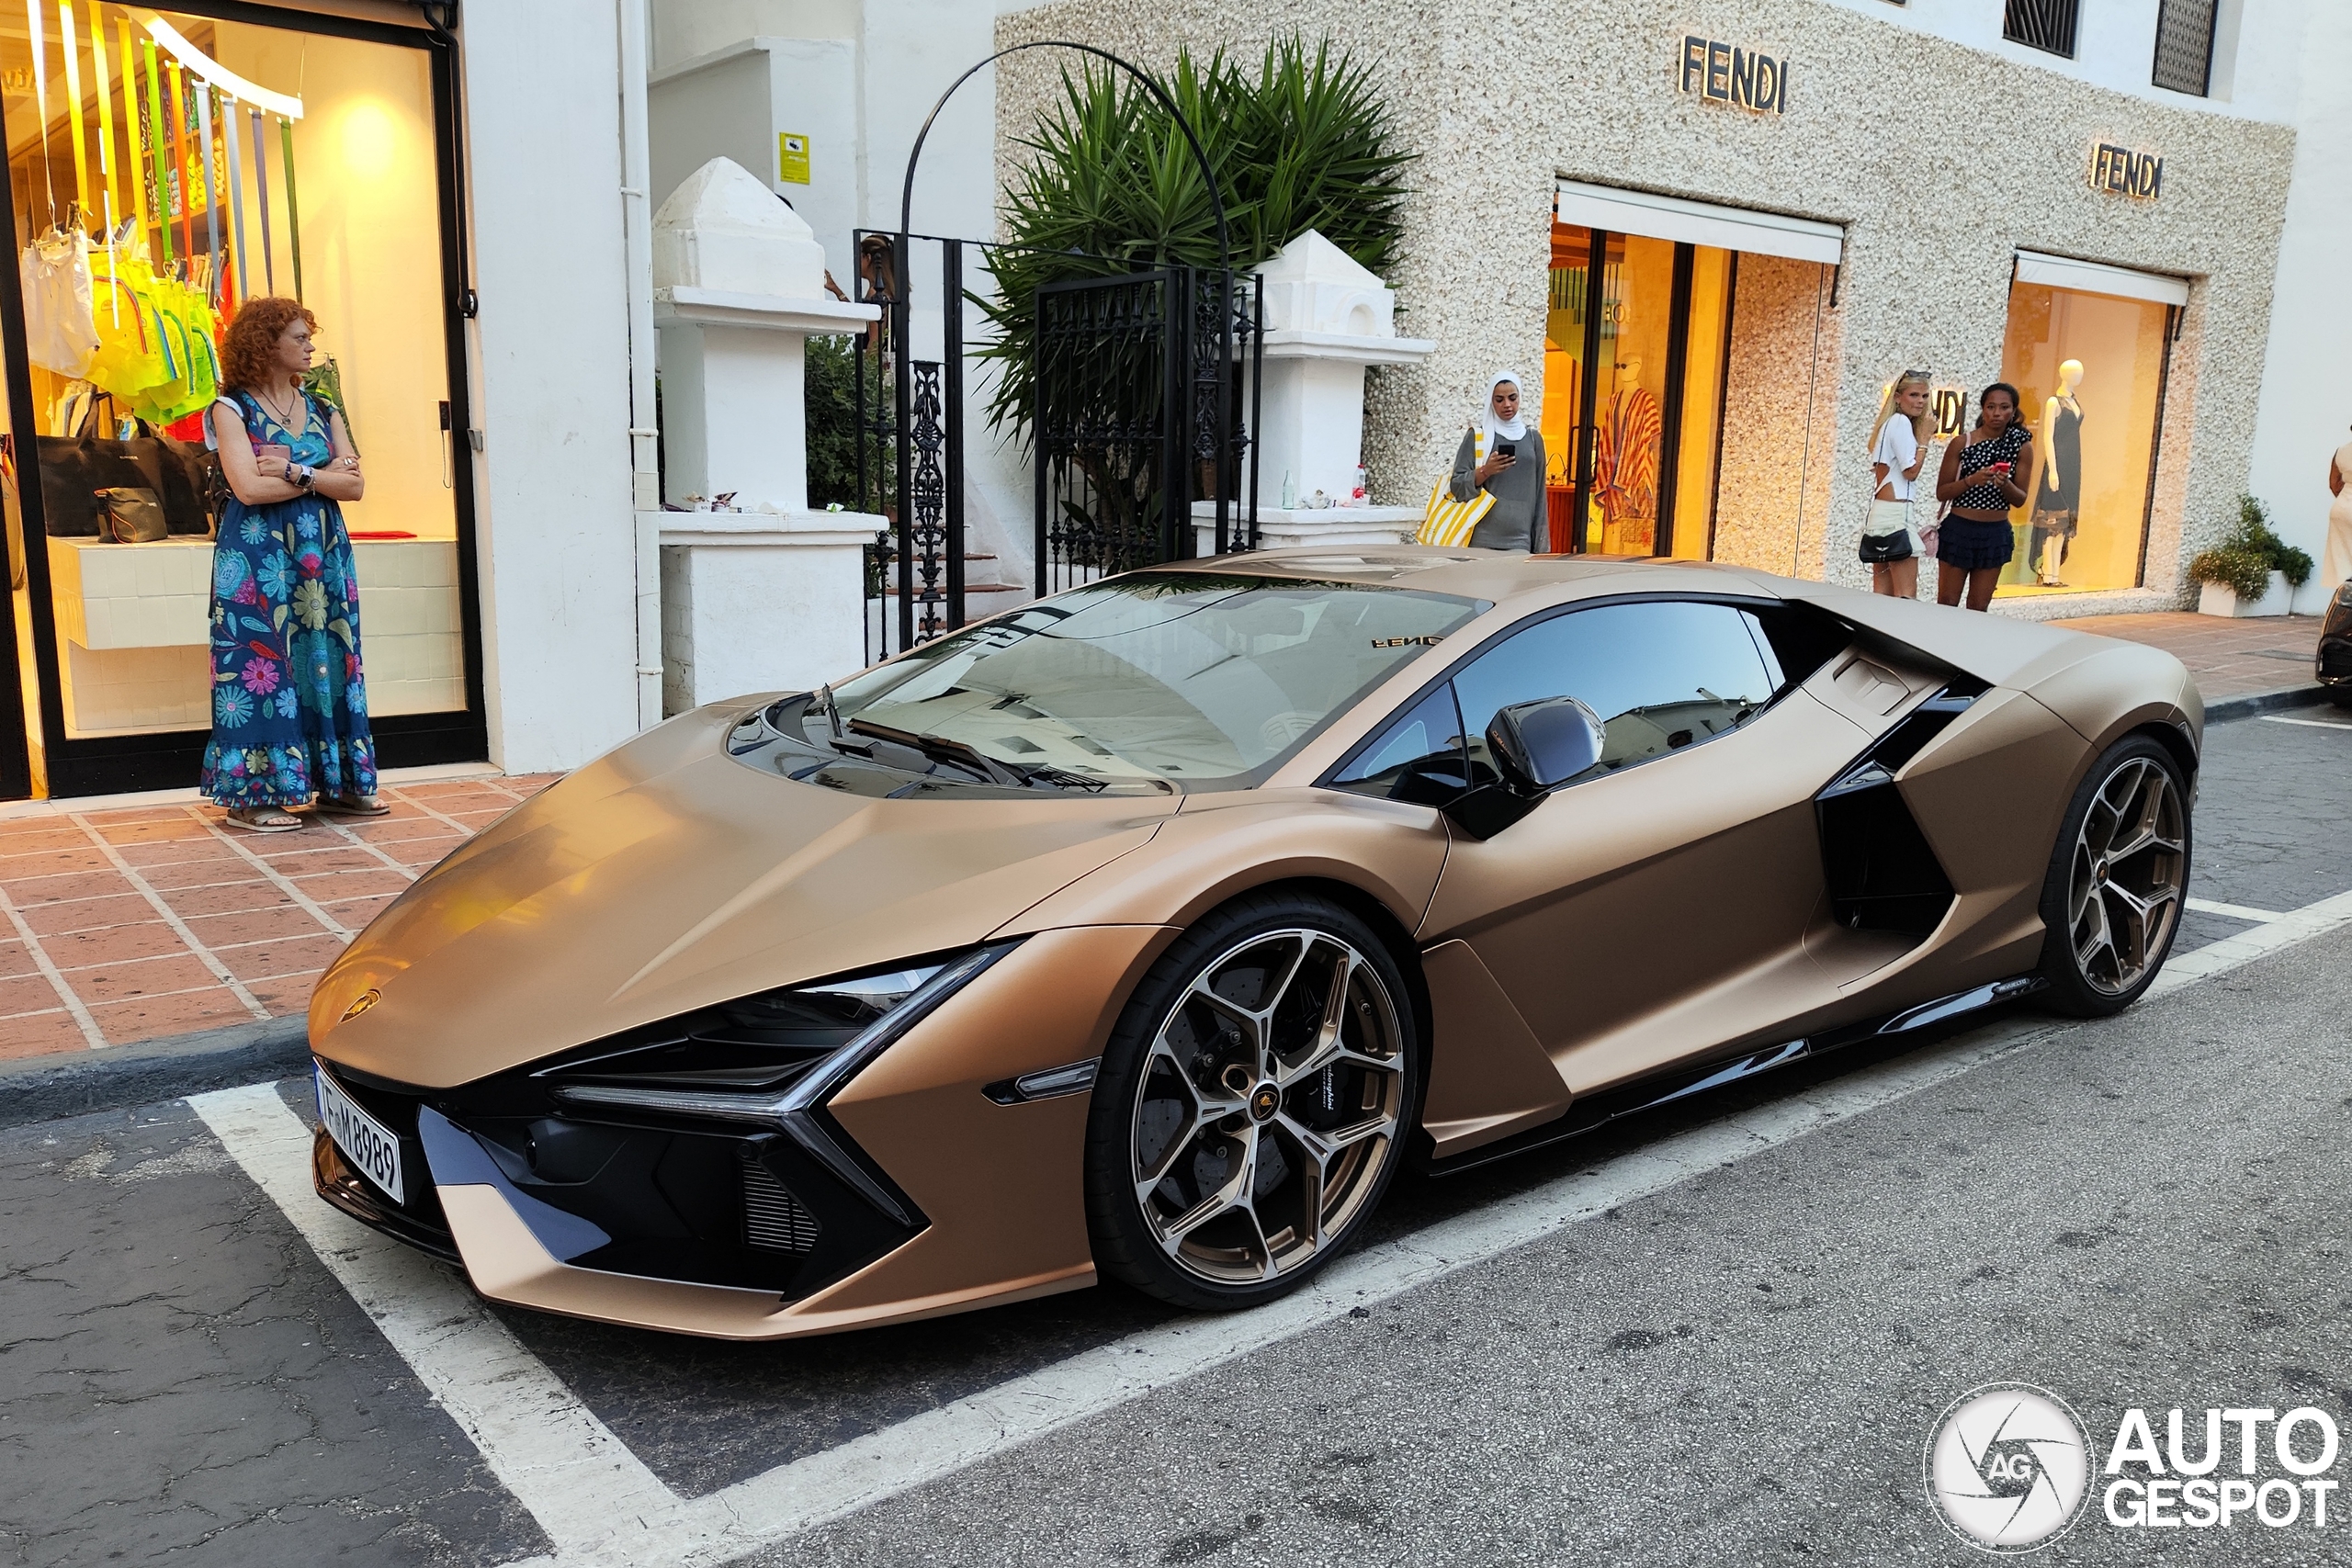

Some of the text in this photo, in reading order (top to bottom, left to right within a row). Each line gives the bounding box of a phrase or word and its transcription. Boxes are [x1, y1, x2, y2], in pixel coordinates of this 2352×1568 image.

[1679, 35, 1788, 115] FENDI
[2090, 142, 2164, 199] FENDI
[1930, 389, 1968, 435] NDI
